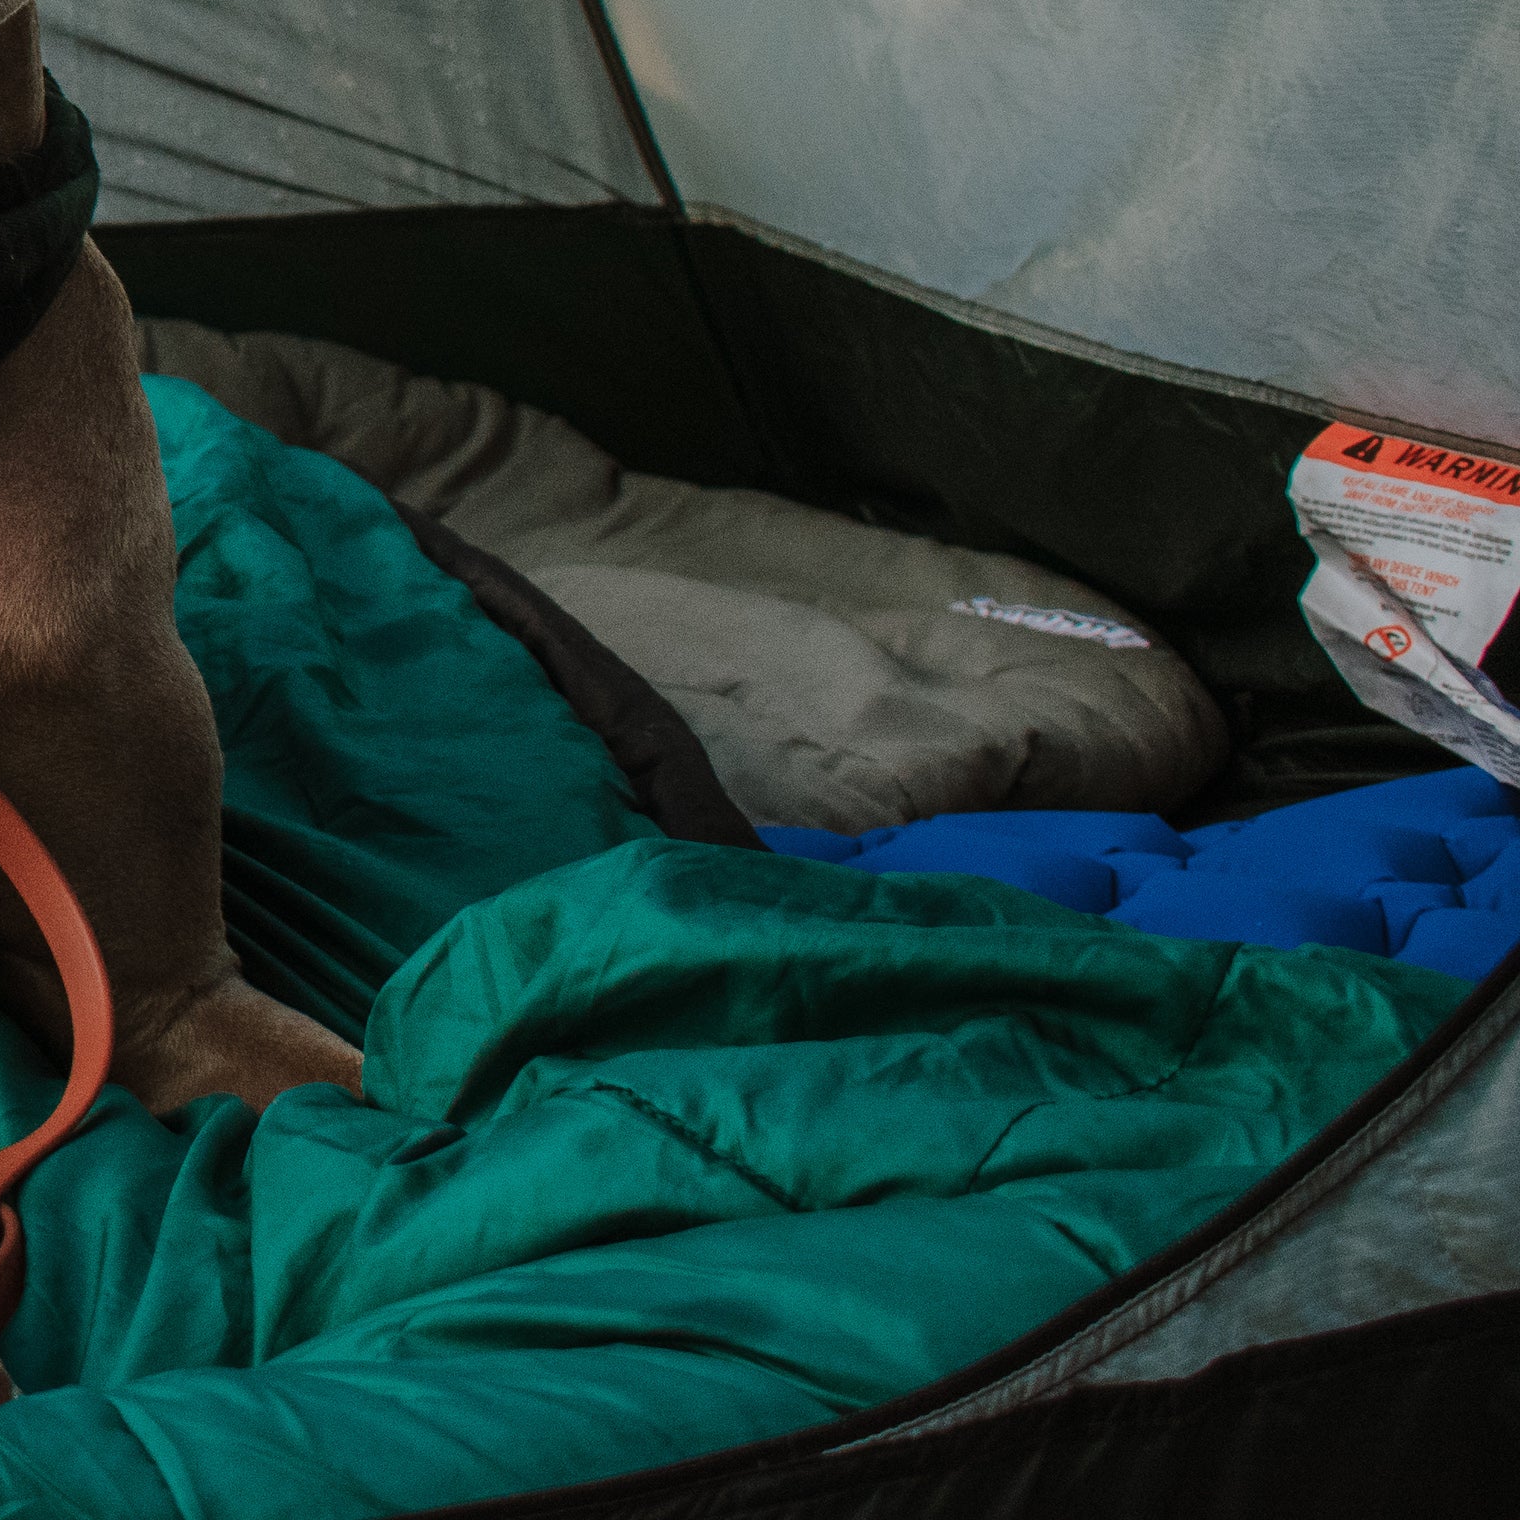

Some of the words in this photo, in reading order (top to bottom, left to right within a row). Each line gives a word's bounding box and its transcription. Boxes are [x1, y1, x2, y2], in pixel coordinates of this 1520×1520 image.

[1393, 443, 1520, 496] WARNIN
[1389, 560, 1424, 578] DEVICE
[1424, 569, 1461, 588] WHICH
[1410, 580, 1438, 597] TENT
